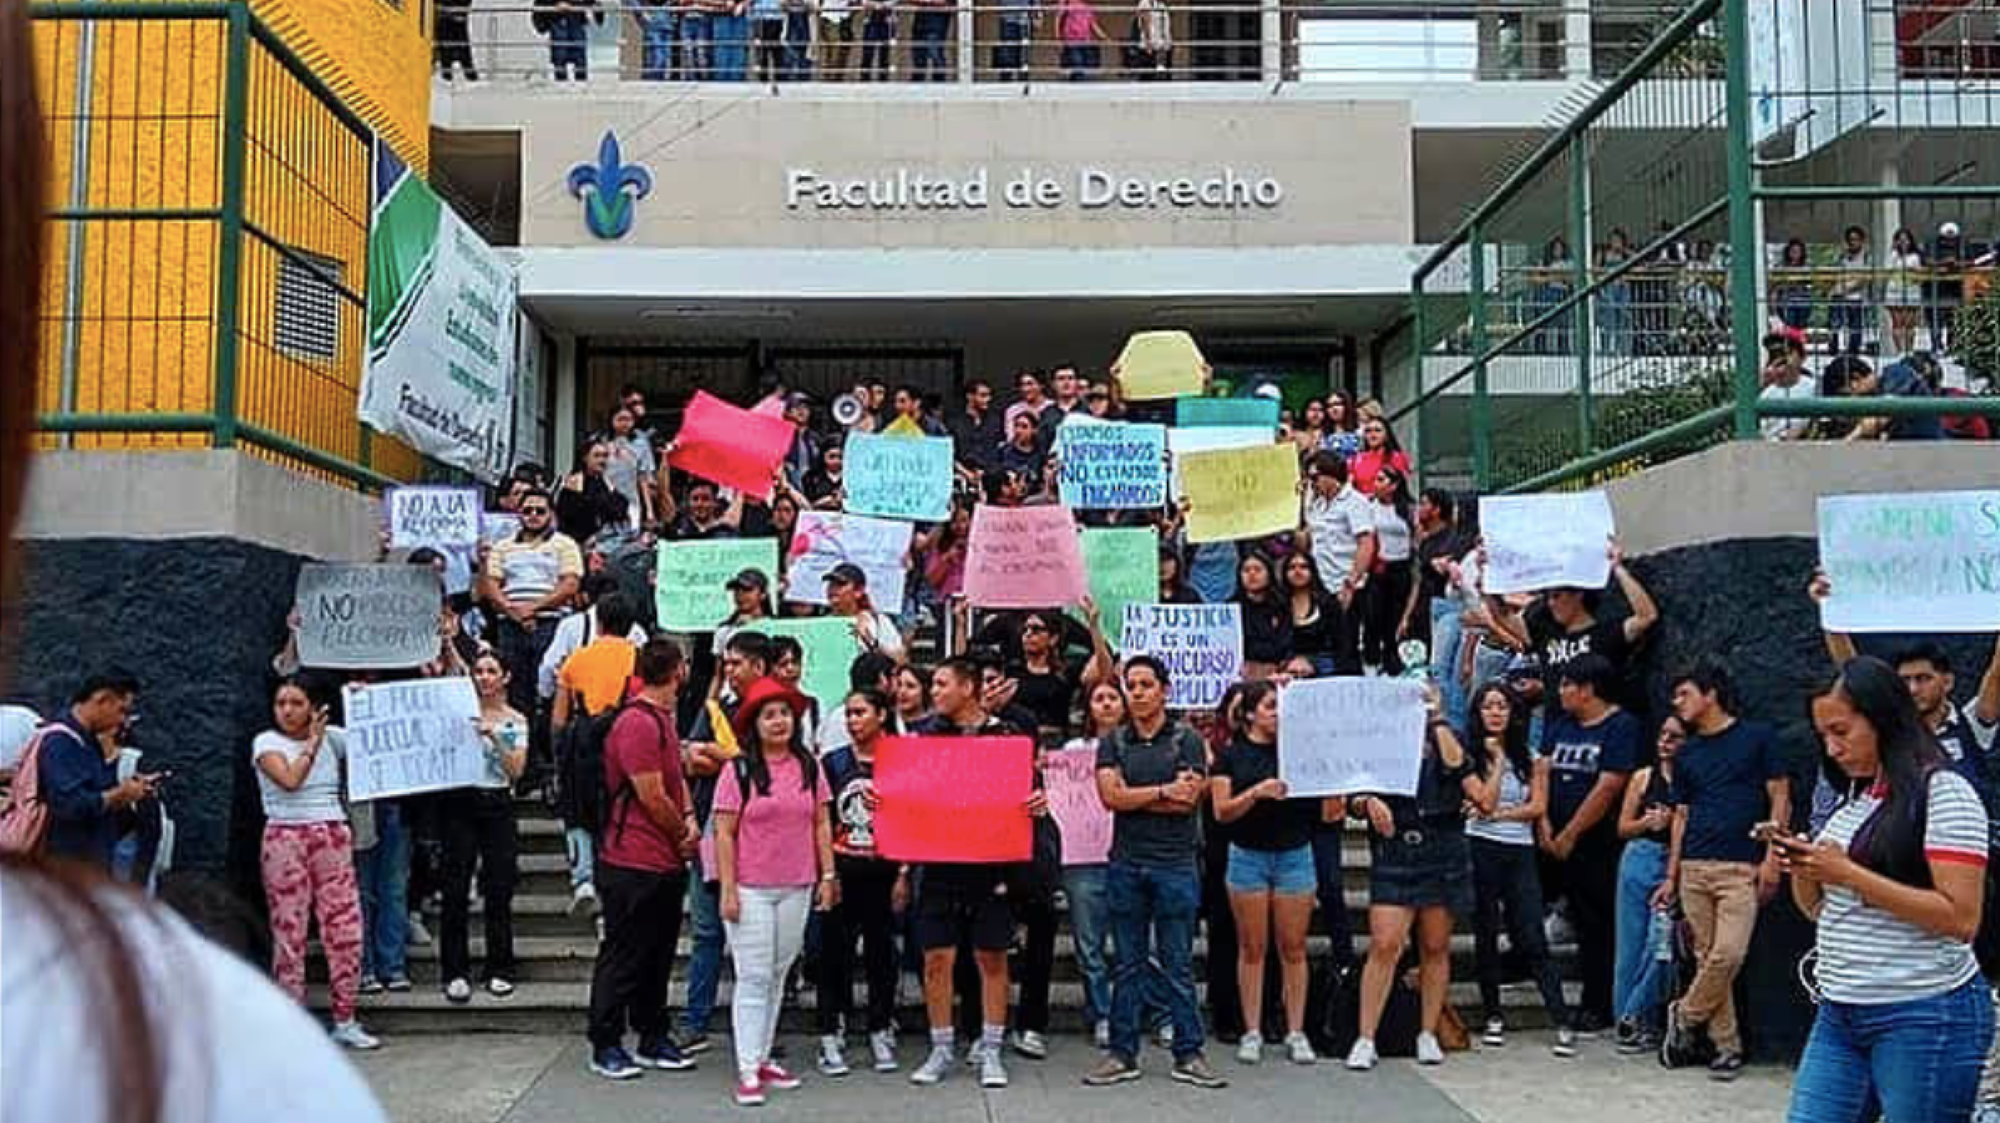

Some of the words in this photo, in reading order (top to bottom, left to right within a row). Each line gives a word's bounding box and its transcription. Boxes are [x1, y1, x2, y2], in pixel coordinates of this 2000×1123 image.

[785, 166, 988, 209] Facultad
[1004, 167, 1062, 208] de
[1079, 166, 1283, 209] Derecho
[1063, 441, 1156, 462] INFORMADOS
[1060, 464, 1089, 484] NO
[448, 493, 466, 515] LA
[318, 593, 356, 622] NO
[1127, 604, 1143, 621] LA
[1151, 606, 1233, 628] JUSTICIA
[1125, 626, 1147, 650] NO
[1161, 633, 1178, 648] ES
[1187, 634, 1209, 649] UN
